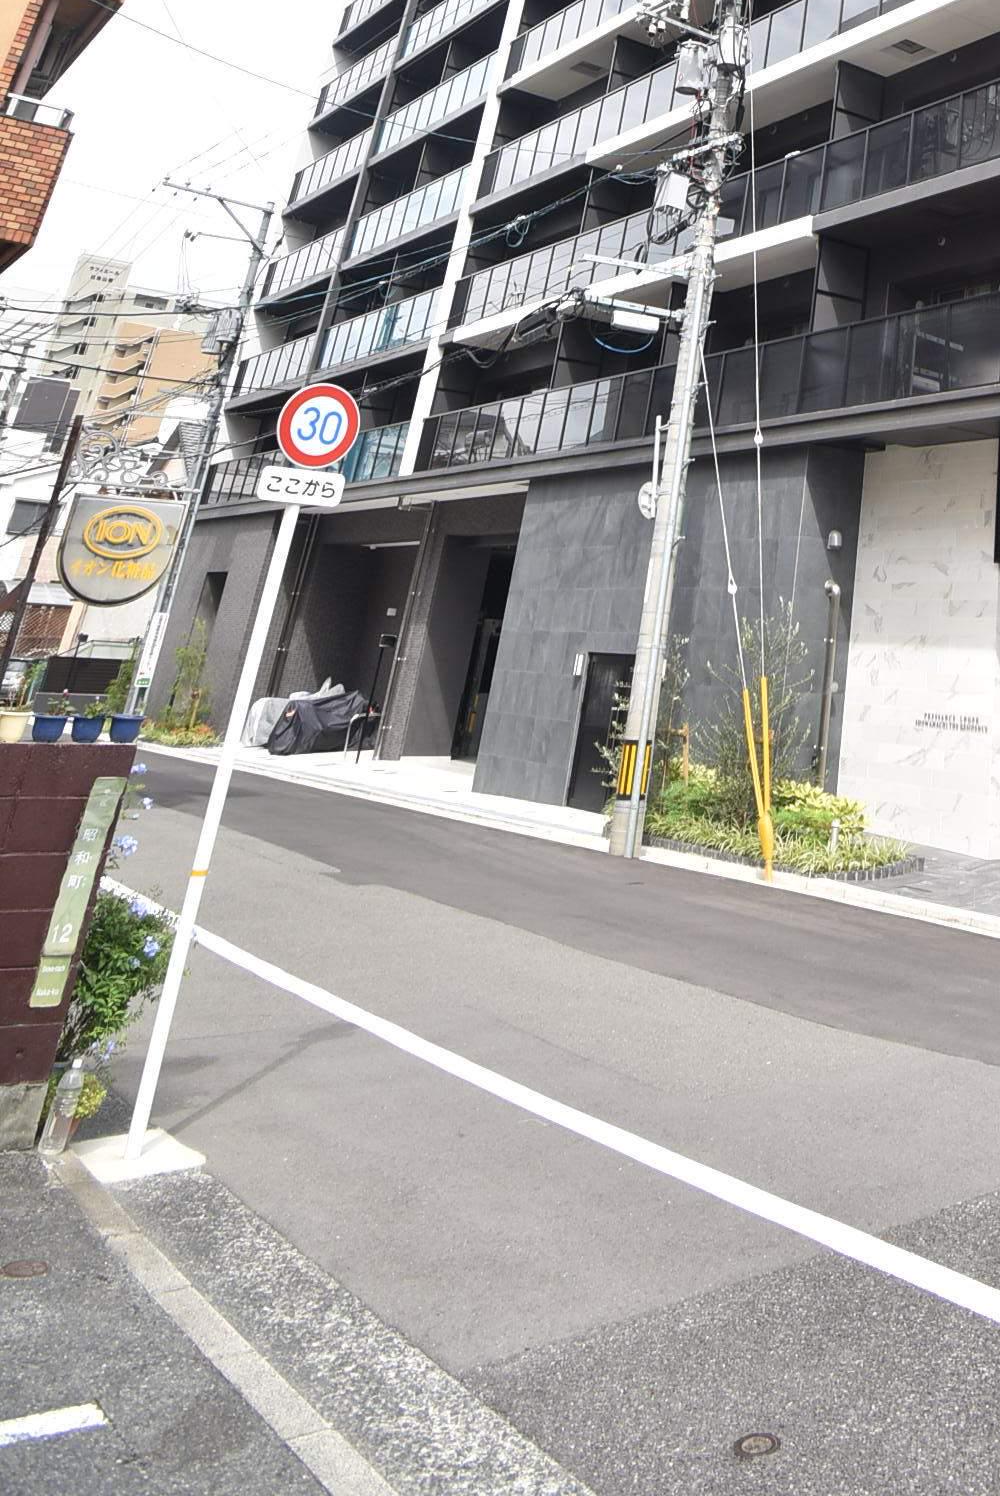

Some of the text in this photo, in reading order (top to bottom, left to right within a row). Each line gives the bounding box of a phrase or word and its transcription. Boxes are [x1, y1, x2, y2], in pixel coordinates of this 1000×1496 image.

[297, 407, 342, 444] 30
[267, 475, 335, 498] ここから
[96, 519, 153, 545] ION
[67, 828, 98, 889] 昭和町
[52, 924, 73, 943] 12
